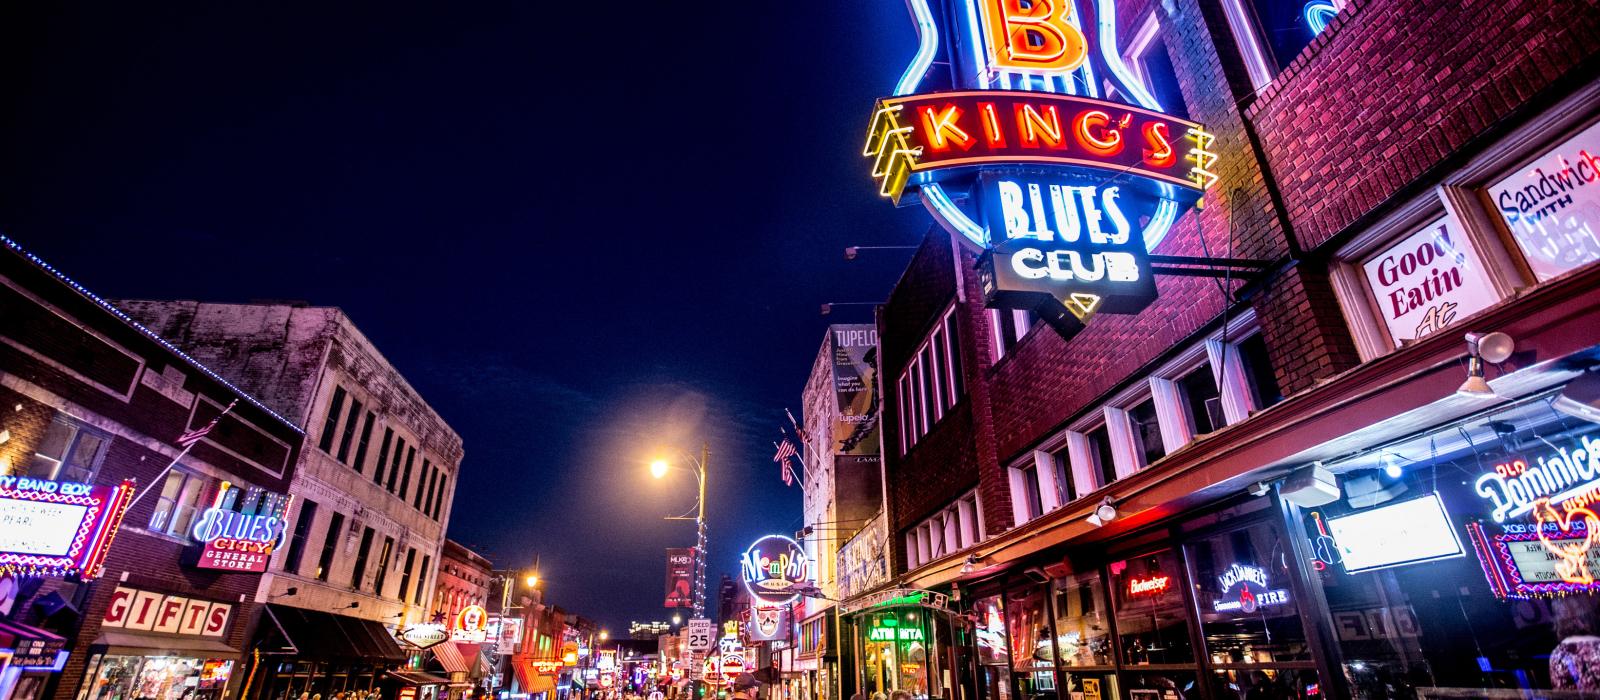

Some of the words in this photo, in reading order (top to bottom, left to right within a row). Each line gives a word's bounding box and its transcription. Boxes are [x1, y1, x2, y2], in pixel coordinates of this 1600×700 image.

[978, 0, 1088, 73] B
[917, 102, 1176, 168] KING'S
[1499, 150, 1600, 226] Sandwich
[999, 180, 1130, 245] BLUES
[1525, 194, 1573, 225] WITH
[1011, 247, 1139, 282] CLUB
[1378, 224, 1455, 287] Good
[1415, 301, 1458, 340] At
[835, 330, 877, 347] TUPELO
[839, 411, 869, 425] tupelo
[17, 478, 58, 492] BAND
[60, 481, 92, 495] BOX
[202, 508, 277, 543] BLUES
[207, 551, 264, 564] GENERAL
[214, 539, 270, 554] CITY
[213, 560, 254, 570] STORE
[741, 550, 808, 583] Memphis
[1131, 576, 1169, 594] Budweiser
[1256, 590, 1287, 605] FIRE
[104, 591, 227, 632] GIFTS
[689, 635, 709, 647] 25
